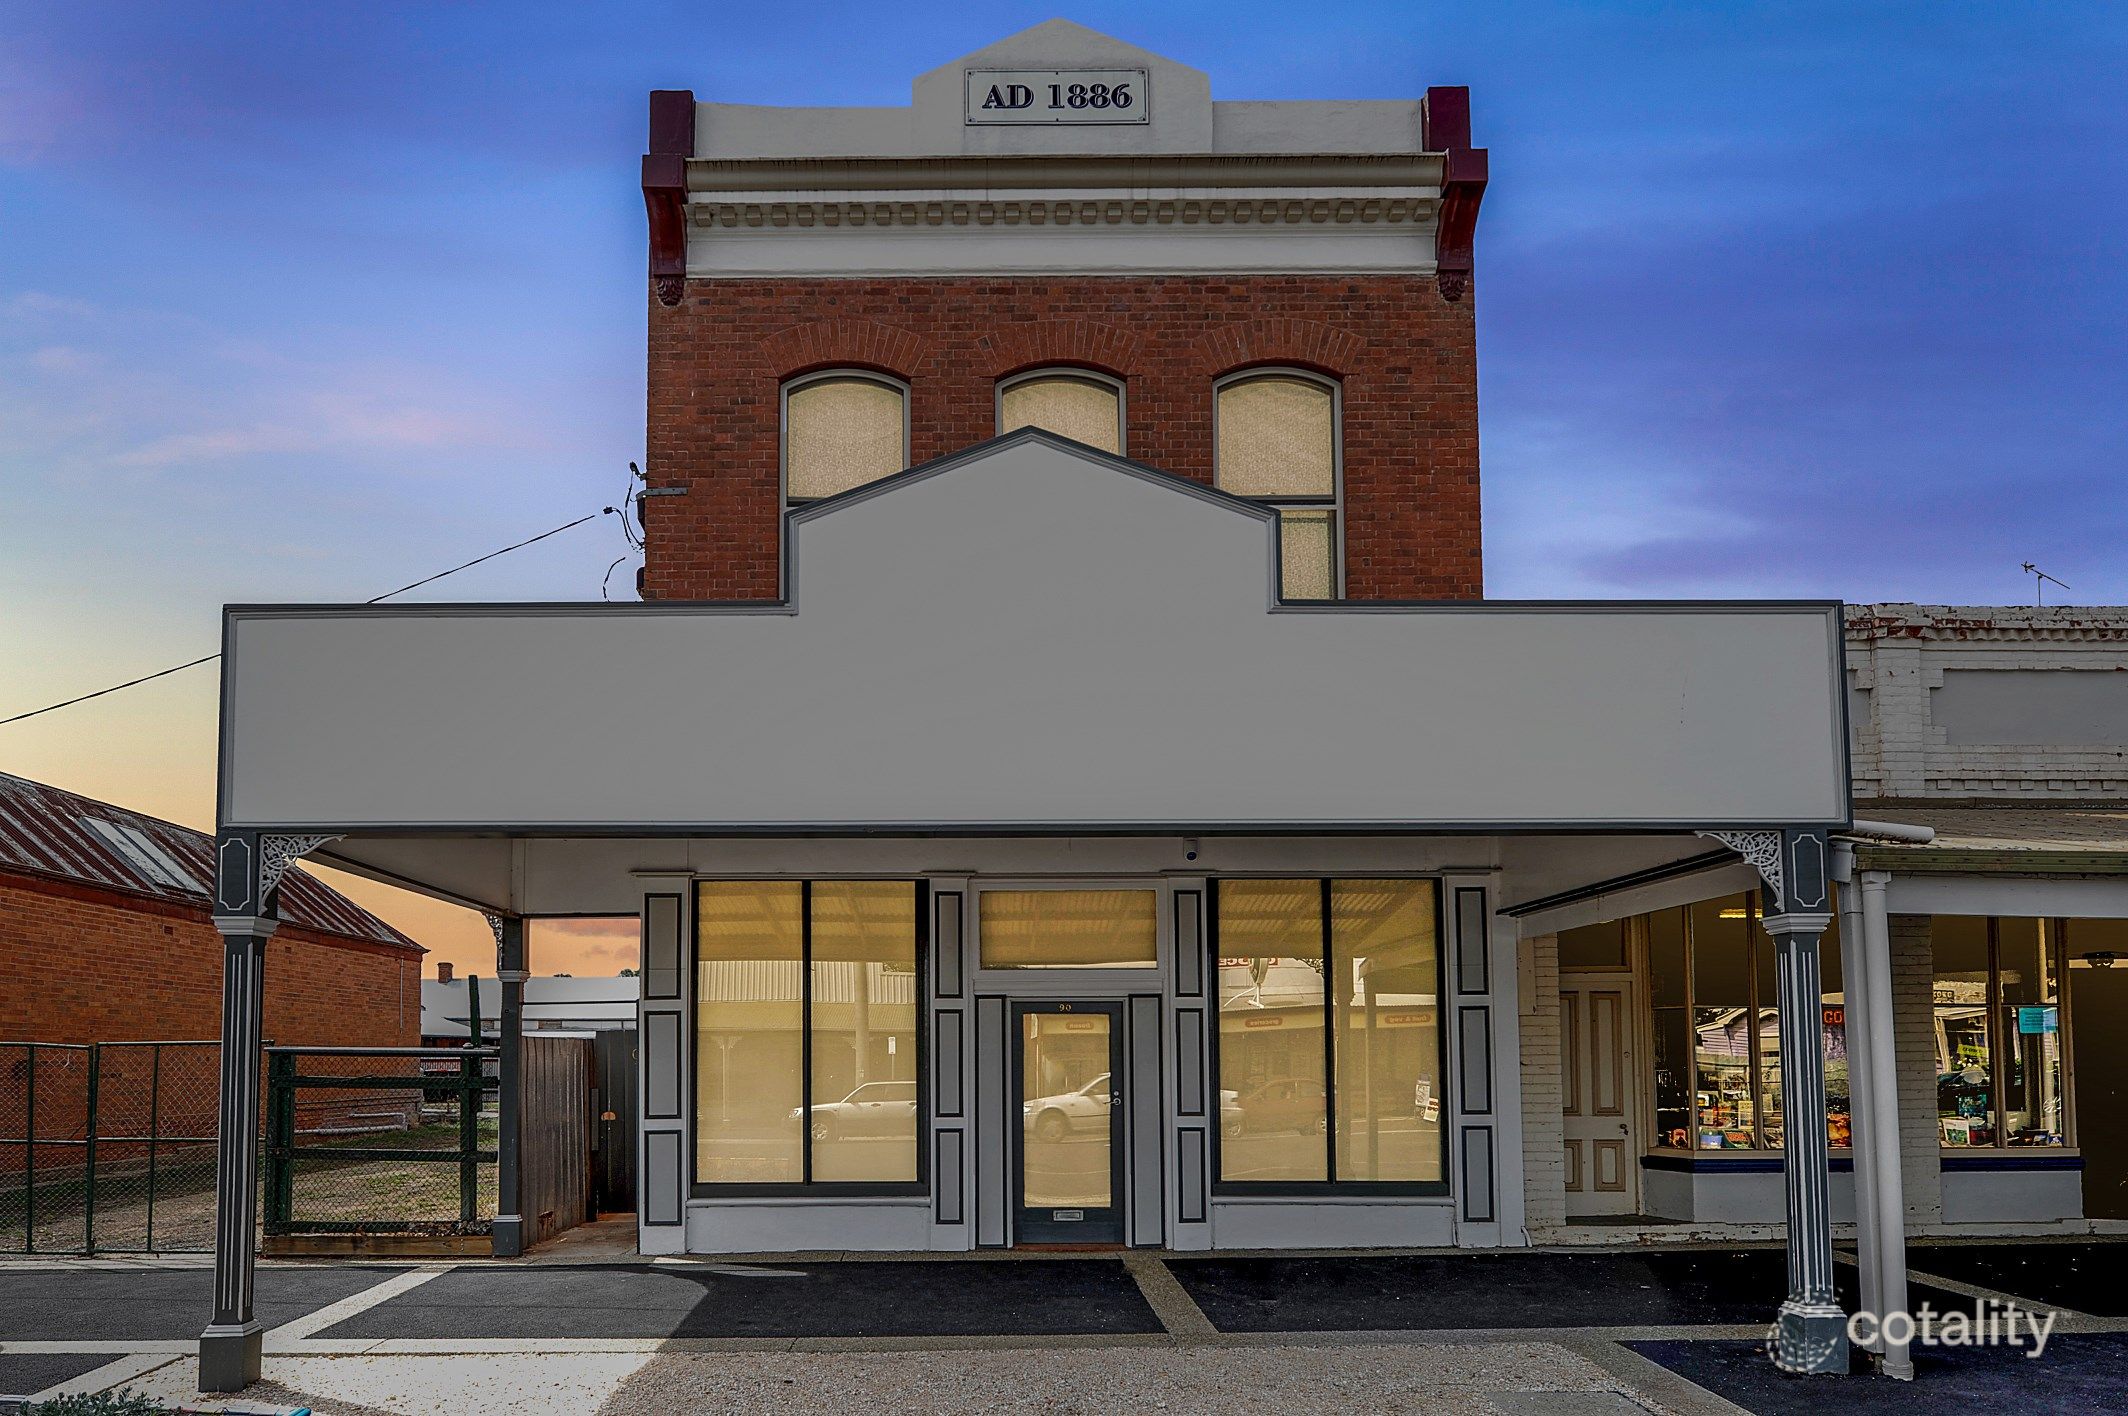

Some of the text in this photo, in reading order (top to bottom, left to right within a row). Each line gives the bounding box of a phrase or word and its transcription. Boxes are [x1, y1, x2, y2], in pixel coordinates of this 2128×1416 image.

[981, 83, 1133, 109] AD 1886
[1059, 1003, 1072, 1012] 90
